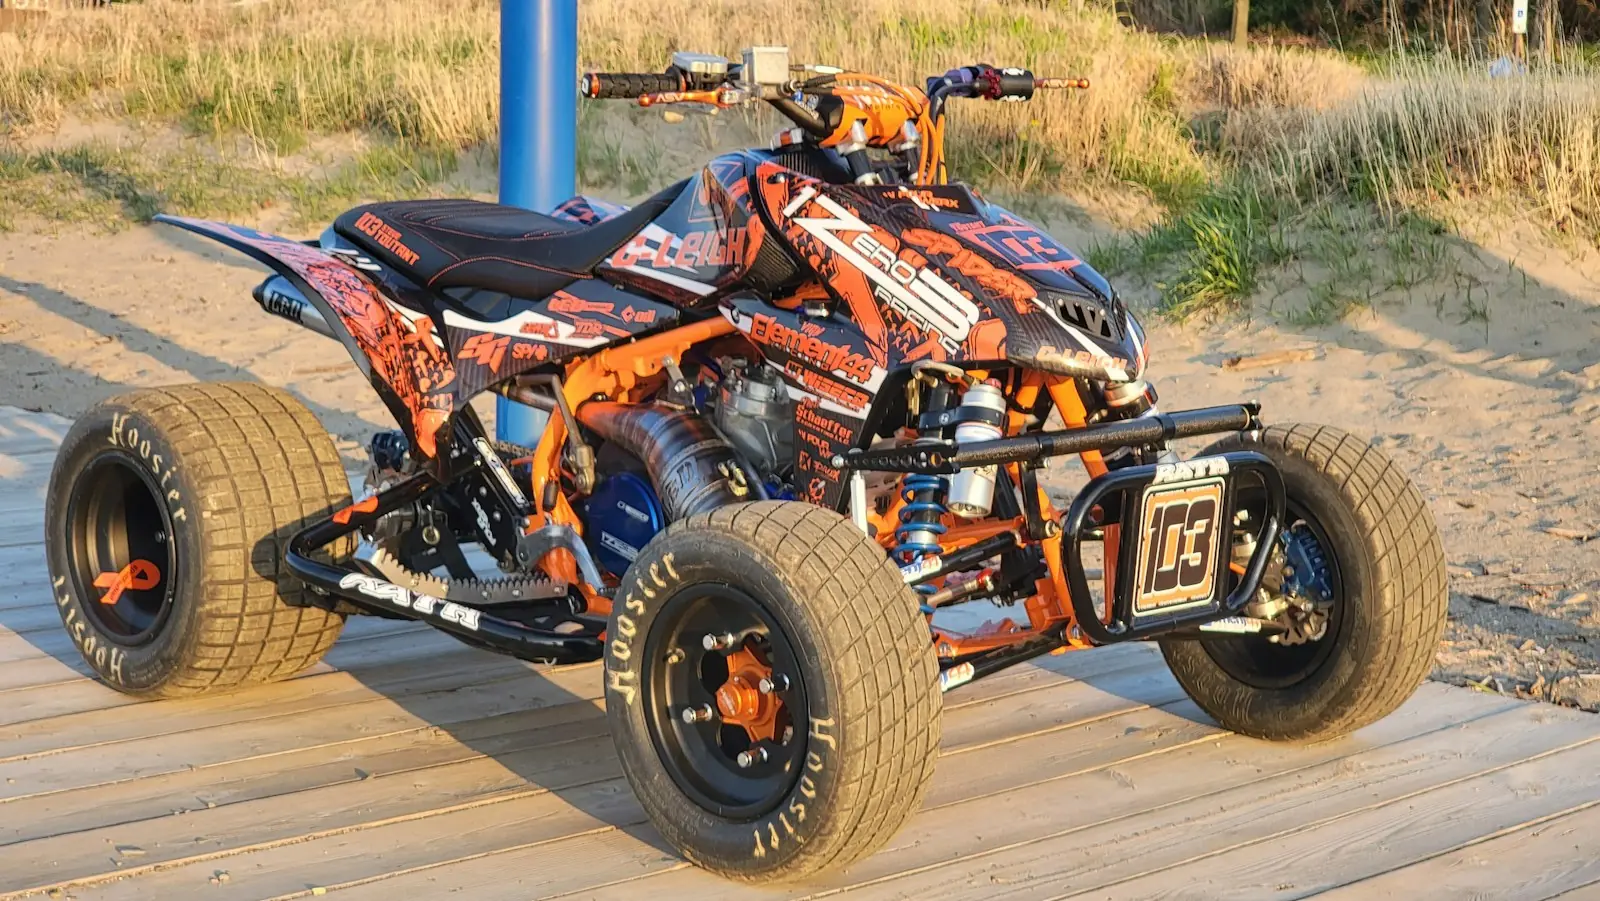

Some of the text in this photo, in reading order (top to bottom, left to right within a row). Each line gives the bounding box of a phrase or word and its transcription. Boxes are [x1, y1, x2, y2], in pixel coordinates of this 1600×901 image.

[656, 93, 686, 103] ASV
[750, 312, 877, 384] Element44
[107, 411, 187, 522] Hoosier
[795, 403, 854, 440] Schaeffer
[1142, 496, 1216, 598] 103
[608, 552, 680, 706] Hoosier
[753, 716, 837, 858] Hoosier
